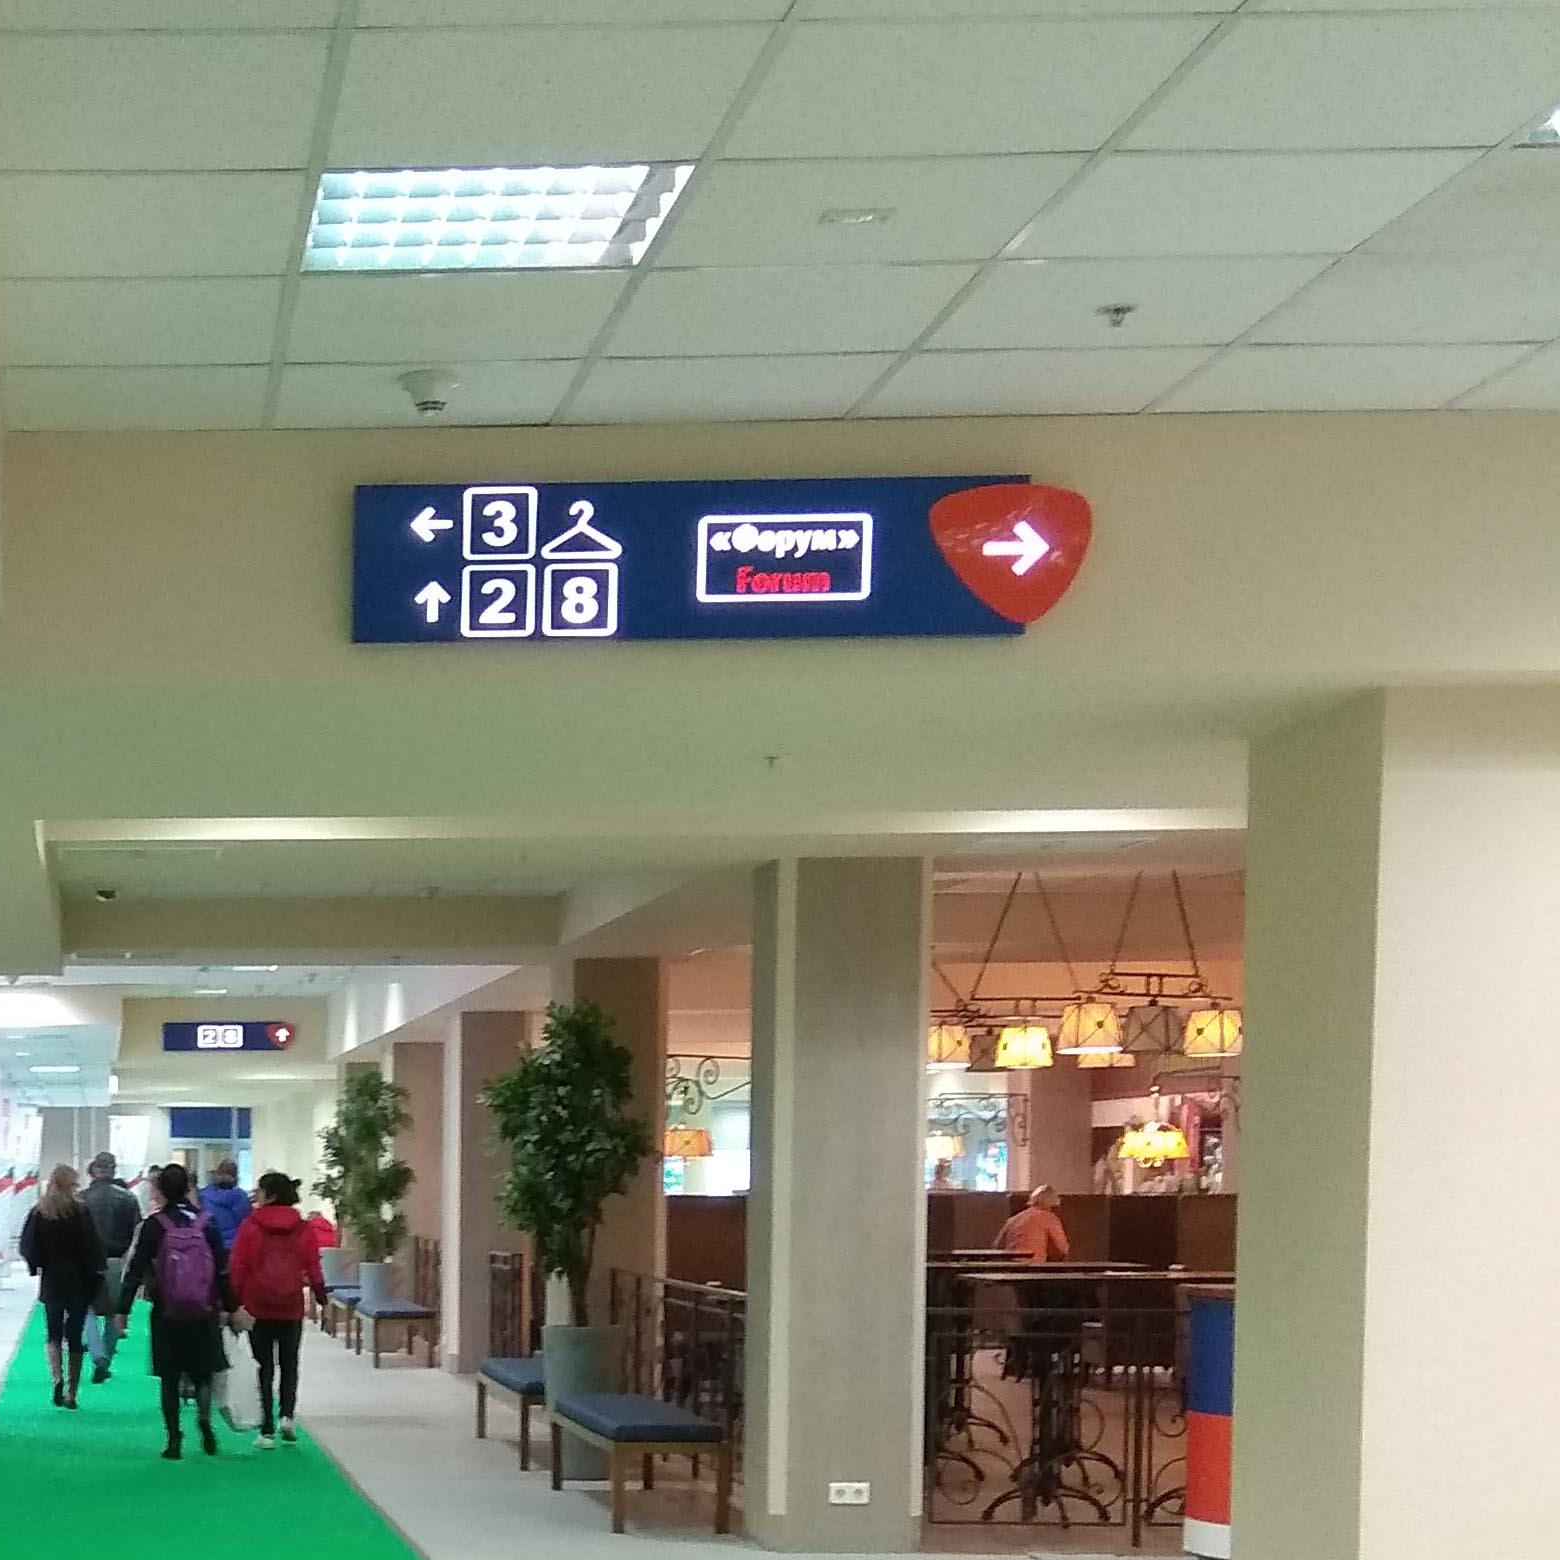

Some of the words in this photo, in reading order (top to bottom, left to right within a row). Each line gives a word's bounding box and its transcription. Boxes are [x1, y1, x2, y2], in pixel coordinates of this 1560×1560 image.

[482, 500, 517, 546] 3
[478, 578, 516, 623] 2
[561, 576, 599, 624] 8
[736, 565, 832, 593] Forum
